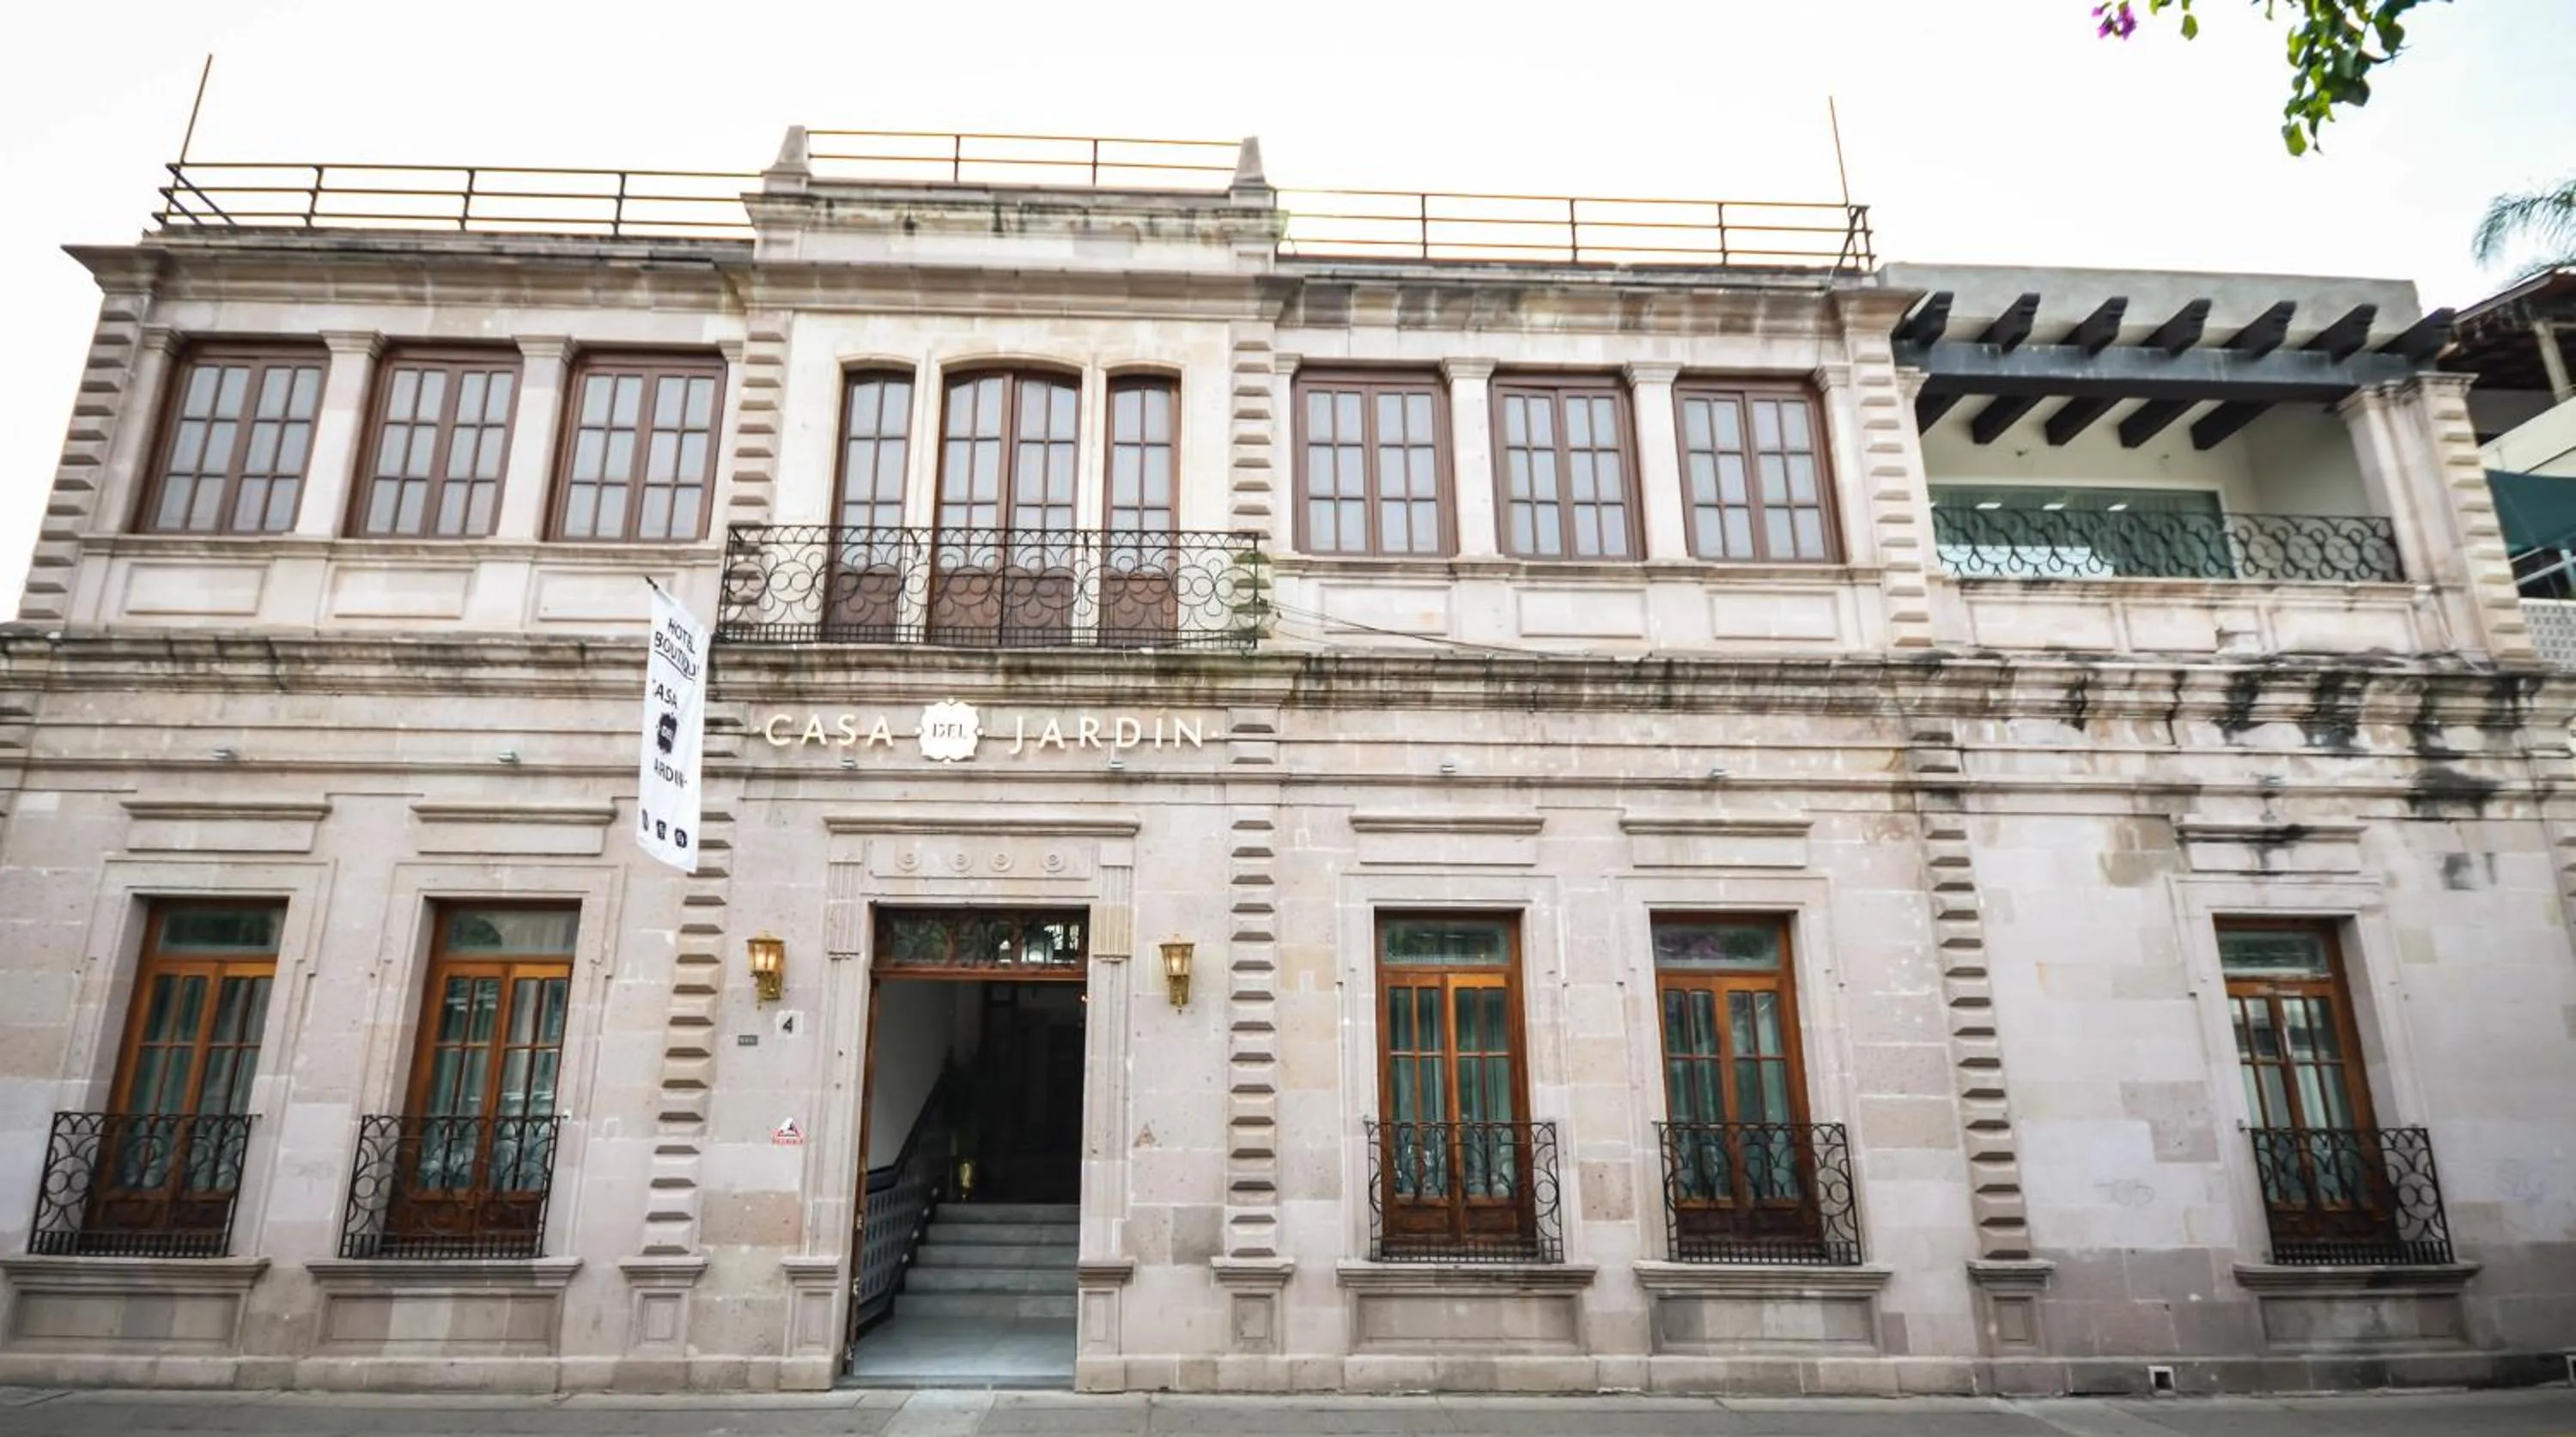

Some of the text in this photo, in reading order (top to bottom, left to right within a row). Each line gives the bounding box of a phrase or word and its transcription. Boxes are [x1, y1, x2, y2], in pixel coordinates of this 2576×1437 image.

[653, 631, 700, 676] BOUTIQU
[653, 678, 677, 709] ASA
[765, 713, 895, 748] CASA
[1009, 706, 1203, 755] JARDÍN
